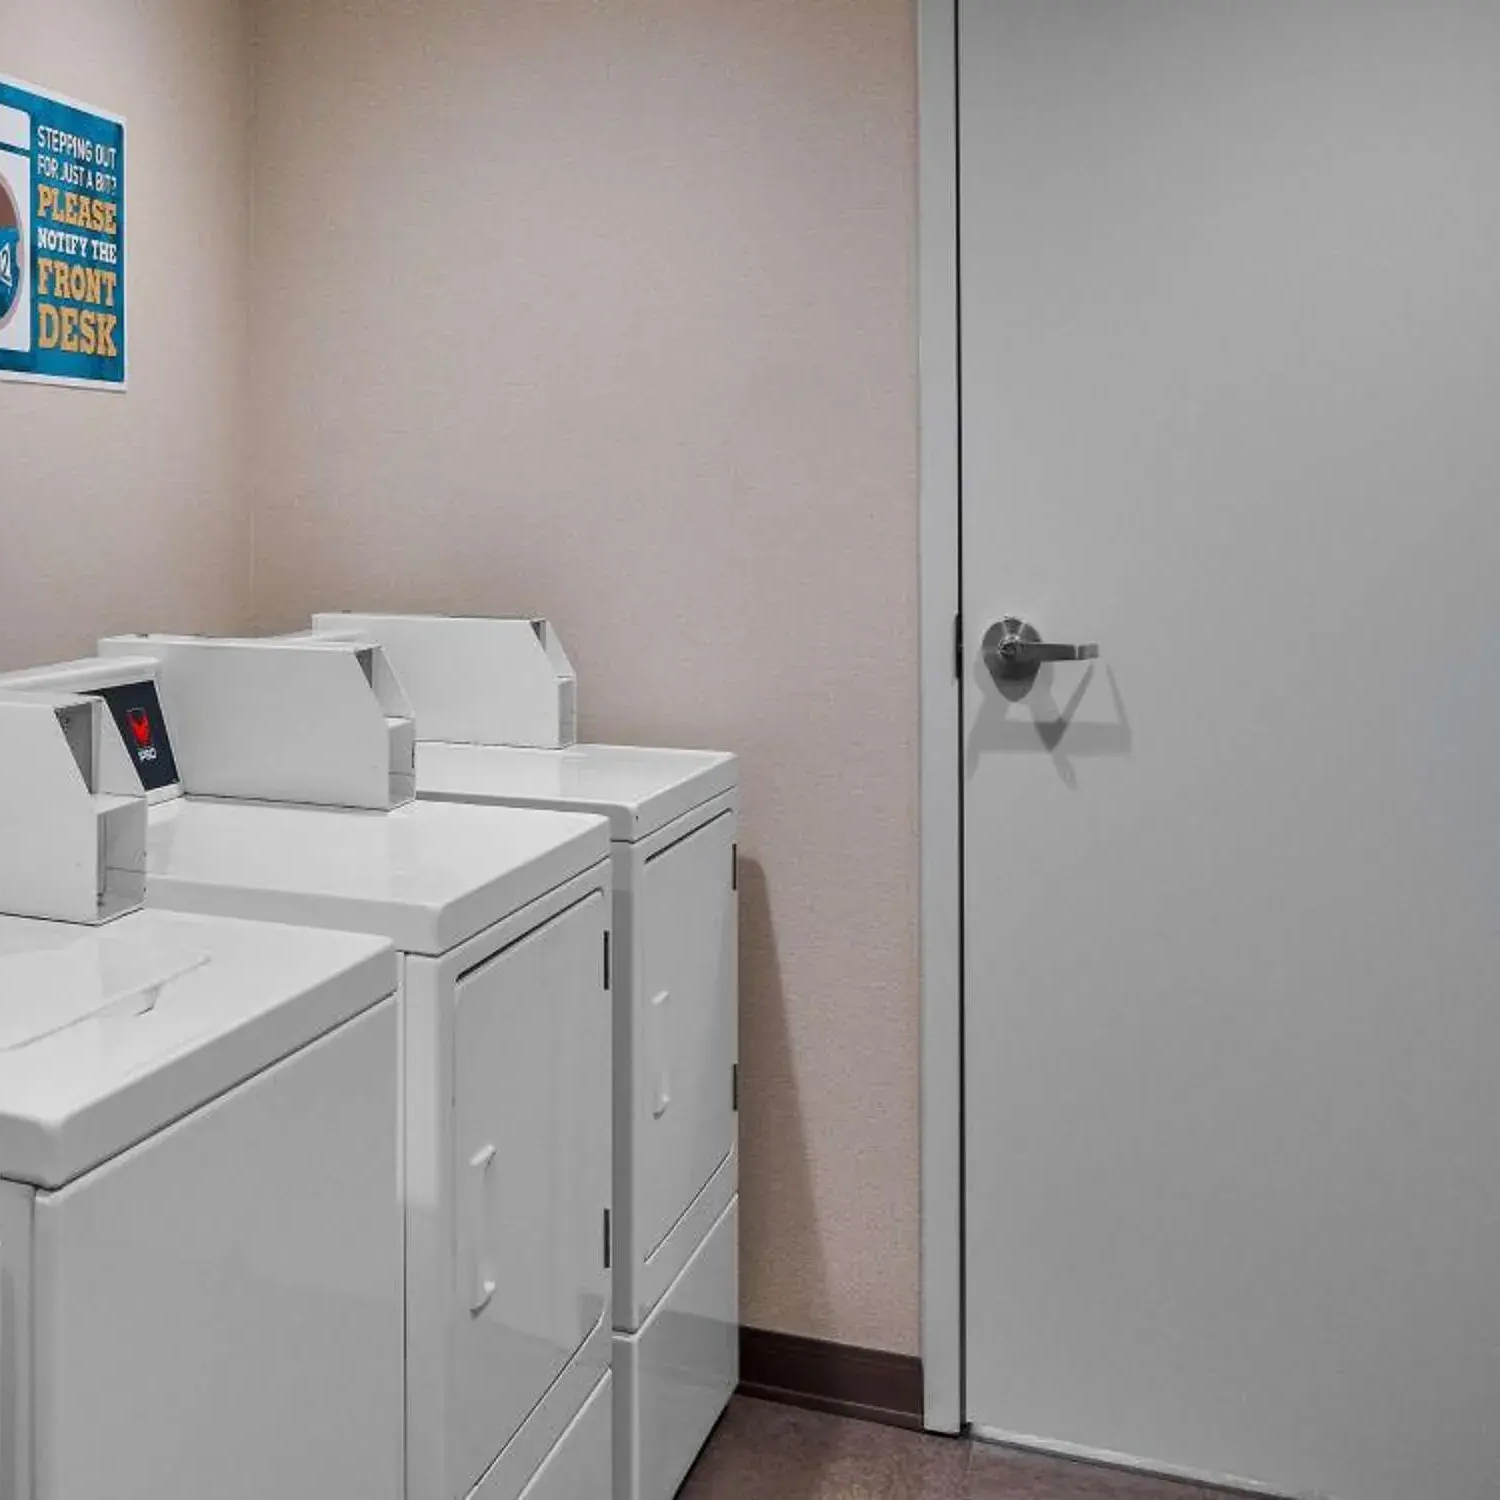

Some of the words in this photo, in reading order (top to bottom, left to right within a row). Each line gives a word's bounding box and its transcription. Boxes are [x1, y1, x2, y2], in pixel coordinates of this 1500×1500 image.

[37, 125, 93, 162] STEPPING
[95, 144, 117, 170] OUT
[37, 153, 58, 180] FOR
[60, 161, 85, 186] JUST
[86, 170, 94, 190] A
[37, 183, 117, 235] PLEASE
[37, 226, 89, 258] NOTIFY
[91, 239, 117, 264] THE
[37, 257, 117, 307] FRONT
[37, 303, 117, 356] DESK
